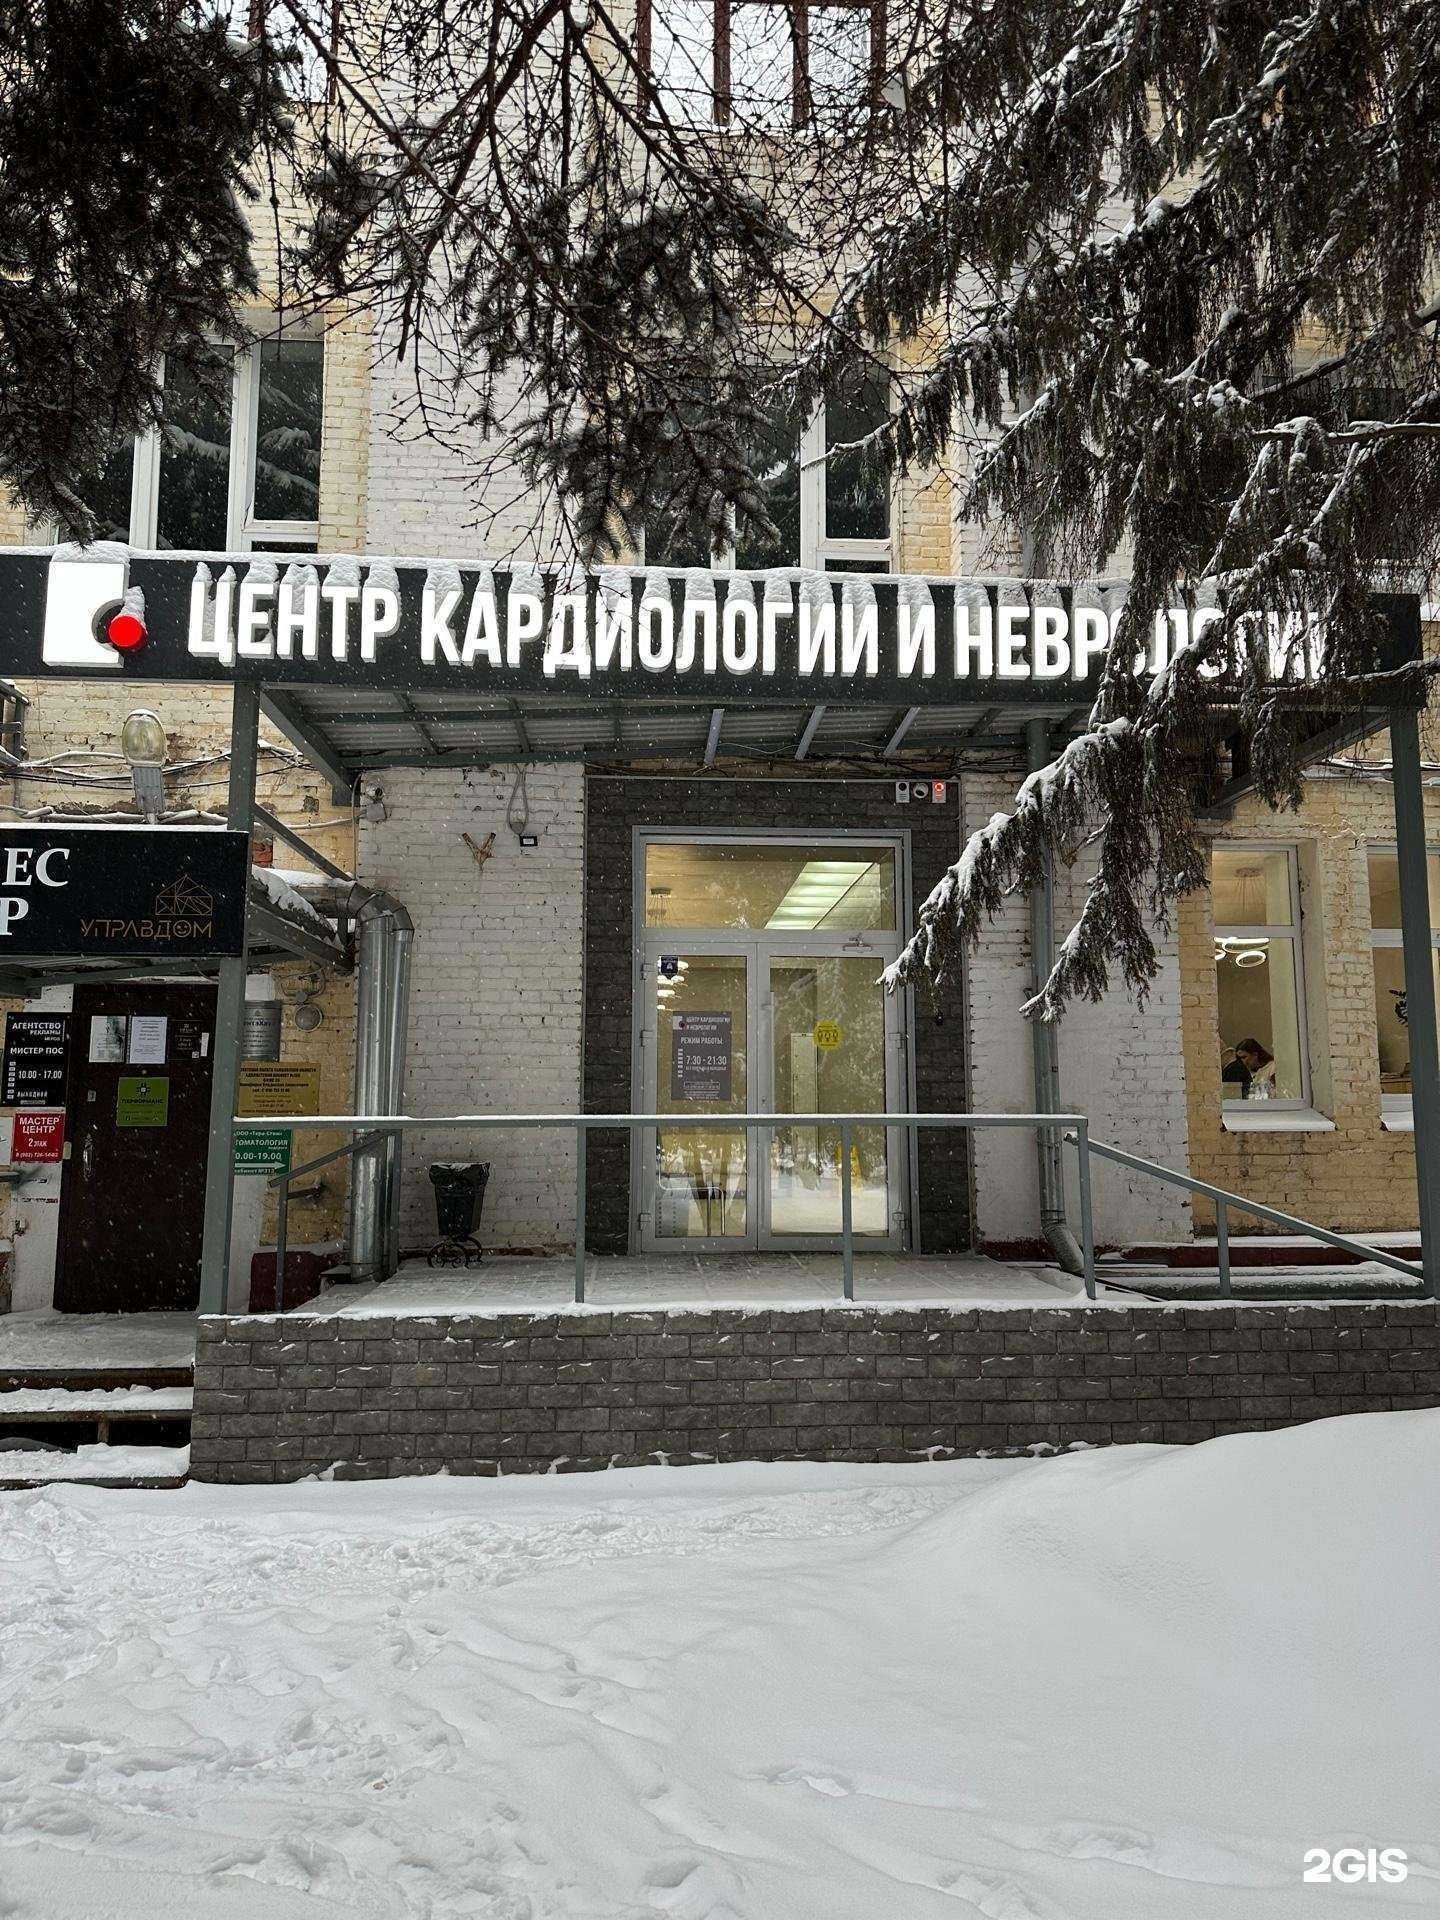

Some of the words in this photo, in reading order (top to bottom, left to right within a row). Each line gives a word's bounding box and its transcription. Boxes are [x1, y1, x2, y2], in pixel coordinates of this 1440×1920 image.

[188, 581, 400, 666] ЦЕНТР
[421, 588, 880, 679] КАРДИОЛОГИИ
[898, 602, 937, 678] И
[954, 604, 1330, 682] НЕВРЛОГИИ
[79, 917, 213, 941] УПРАВДОМ
[12, 1022, 62, 1030] АГЕНТСТВО
[10, 1047, 44, 1055] МИСТЕР
[685, 1055, 701, 1065] 7:30
[707, 1055, 727, 1065] 21:30
[18, 1070, 37, 1079] 10.00
[19, 1116, 60, 1126] МАСТЕР
[22, 1125, 56, 1135] ЦЕНТР
[28, 1137, 34, 1148] 2
